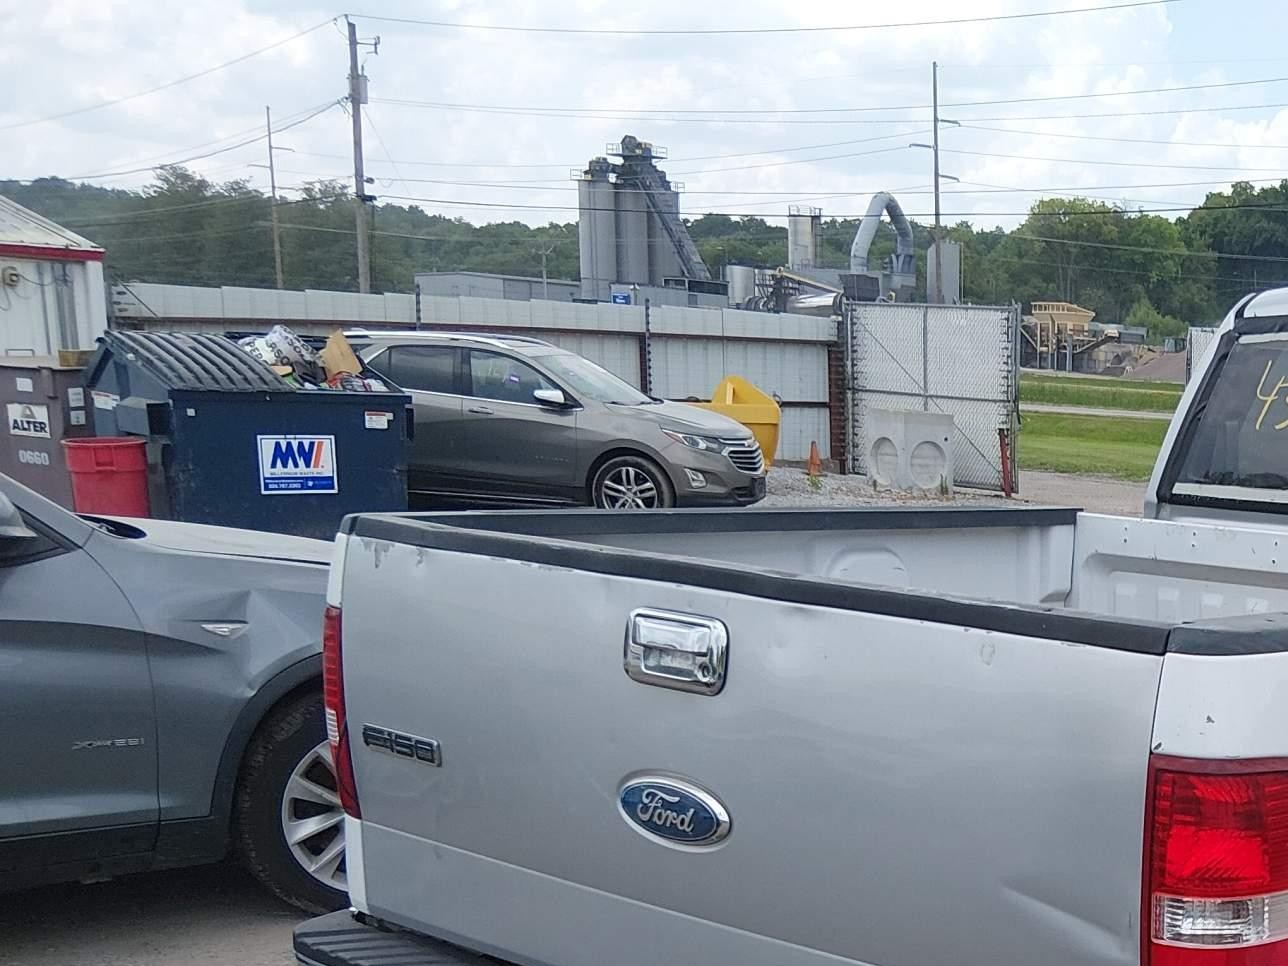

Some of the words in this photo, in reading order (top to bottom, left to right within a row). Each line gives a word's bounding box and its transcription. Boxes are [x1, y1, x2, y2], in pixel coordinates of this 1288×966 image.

[12, 418, 48, 434] ALTER
[18, 449, 50, 466] 0660
[636, 788, 696, 833] Ford
